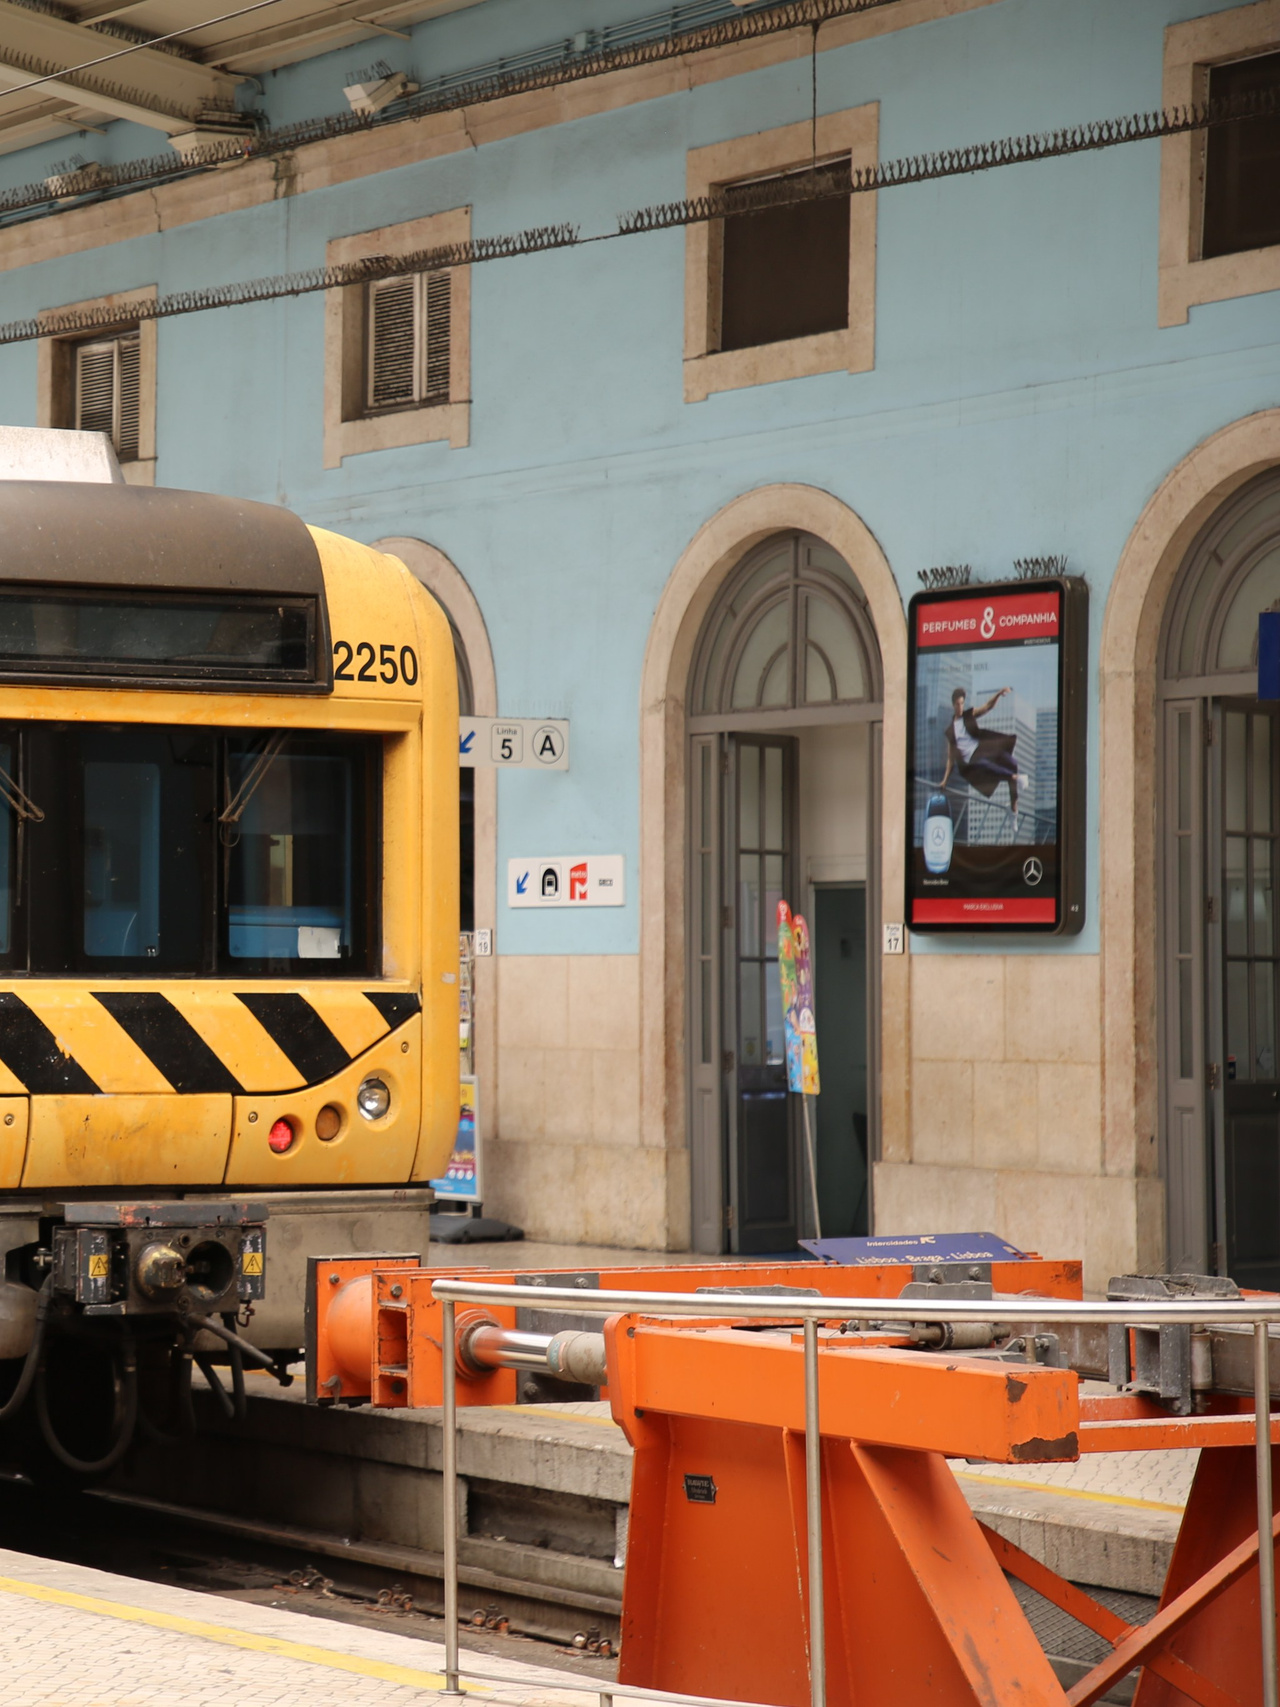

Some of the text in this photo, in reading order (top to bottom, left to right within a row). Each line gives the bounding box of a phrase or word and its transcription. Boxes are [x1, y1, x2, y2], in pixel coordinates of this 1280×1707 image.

[922, 606, 1057, 639] PERFUMES & COMPANHIA
[333, 640, 419, 686] 2250
[496, 727, 518, 736] Linha
[501, 735, 557, 760] 5 A
[888, 937, 900, 951] 17
[866, 1239, 919, 1247] Intercidades
[855, 1256, 900, 1265] Lisboa
[905, 1255, 945, 1263] Braga
[950, 1251, 994, 1260] Lisboa
